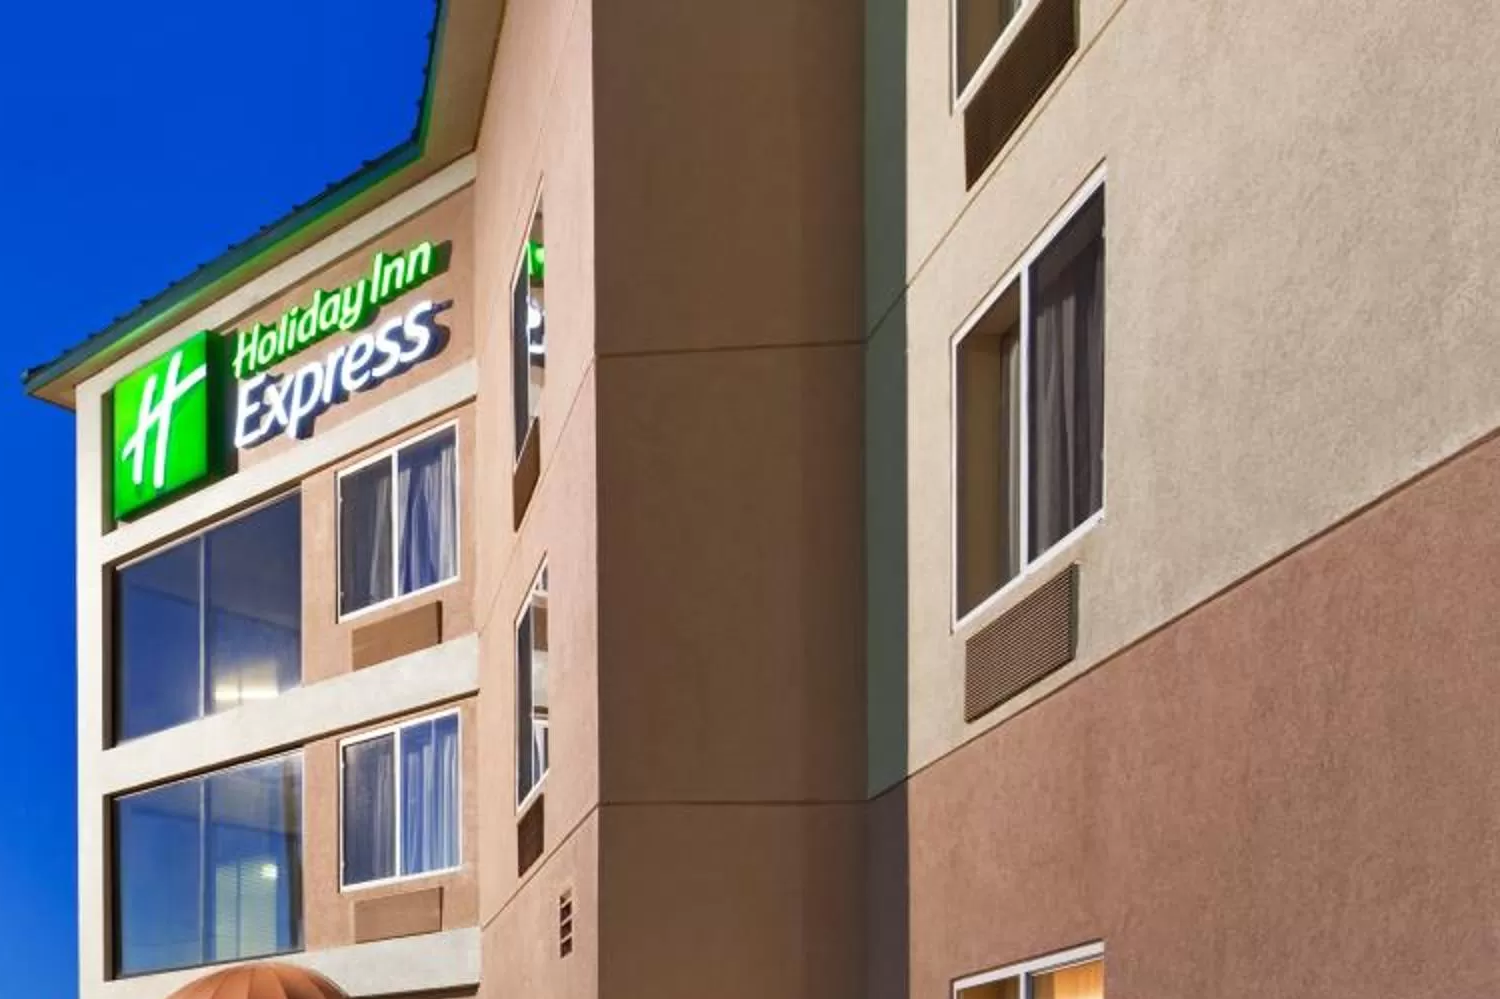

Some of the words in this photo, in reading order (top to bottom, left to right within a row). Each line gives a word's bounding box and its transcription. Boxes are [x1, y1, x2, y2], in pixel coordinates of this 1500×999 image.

[233, 279, 365, 379] Holiday
[370, 242, 431, 303] Inn
[234, 301, 433, 448] Express
